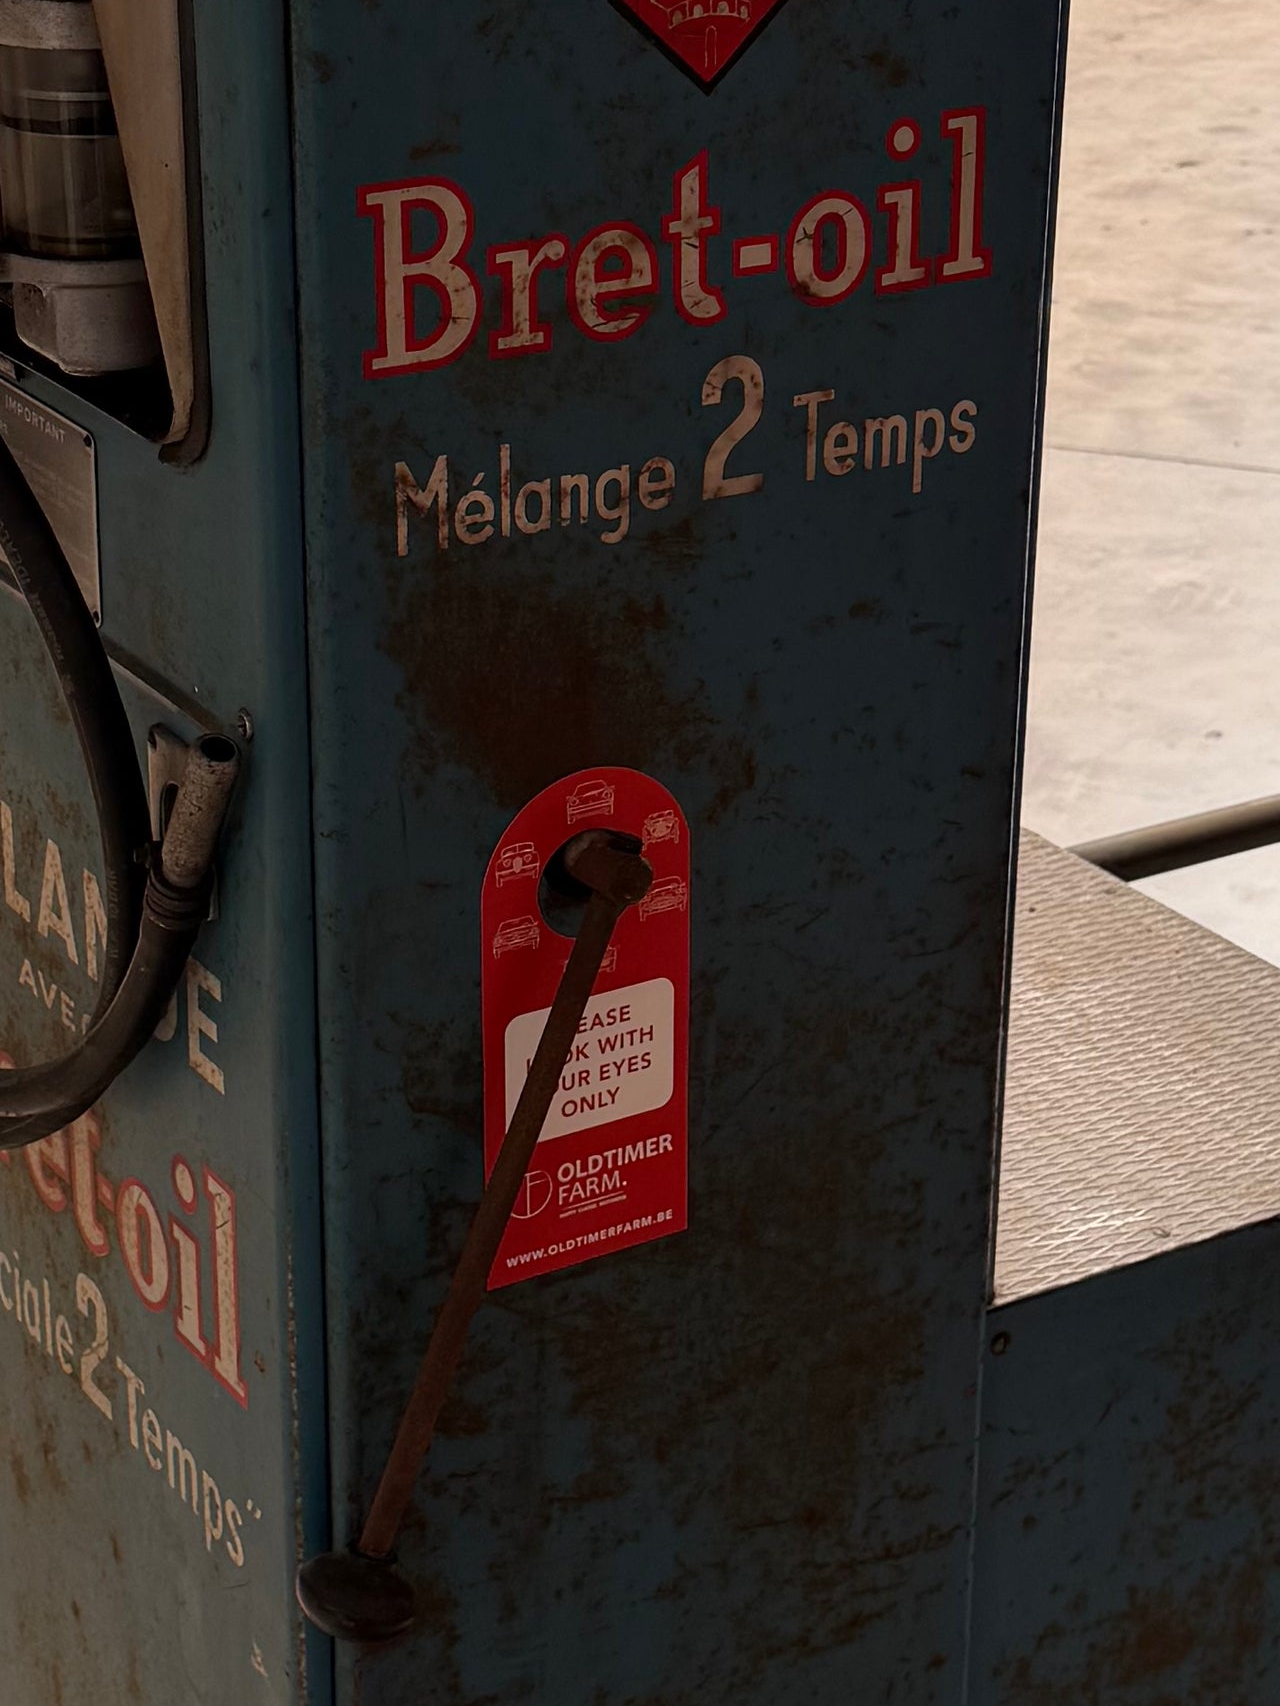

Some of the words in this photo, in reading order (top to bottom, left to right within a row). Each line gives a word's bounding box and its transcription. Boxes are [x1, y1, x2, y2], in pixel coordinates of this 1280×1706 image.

[356, 104, 992, 380] Bret-oil
[5, 394, 65, 443] IMPORTANT
[394, 443, 676, 557] Mélange
[701, 354, 765, 500] 2
[793, 388, 978, 494] Temps
[576, 1005, 631, 1034] EASE
[598, 1025, 654, 1055] WITH
[559, 1069, 590, 1092] UR
[600, 1051, 652, 1082] EYES
[561, 1086, 620, 1118] ONLY
[557, 1133, 673, 1183] OLDTIMER
[559, 1169, 627, 1206] FARM.
[506, 1209, 673, 1269] WWW.OLDTIMERFARM.BE
[76, 1273, 113, 1421] 2
